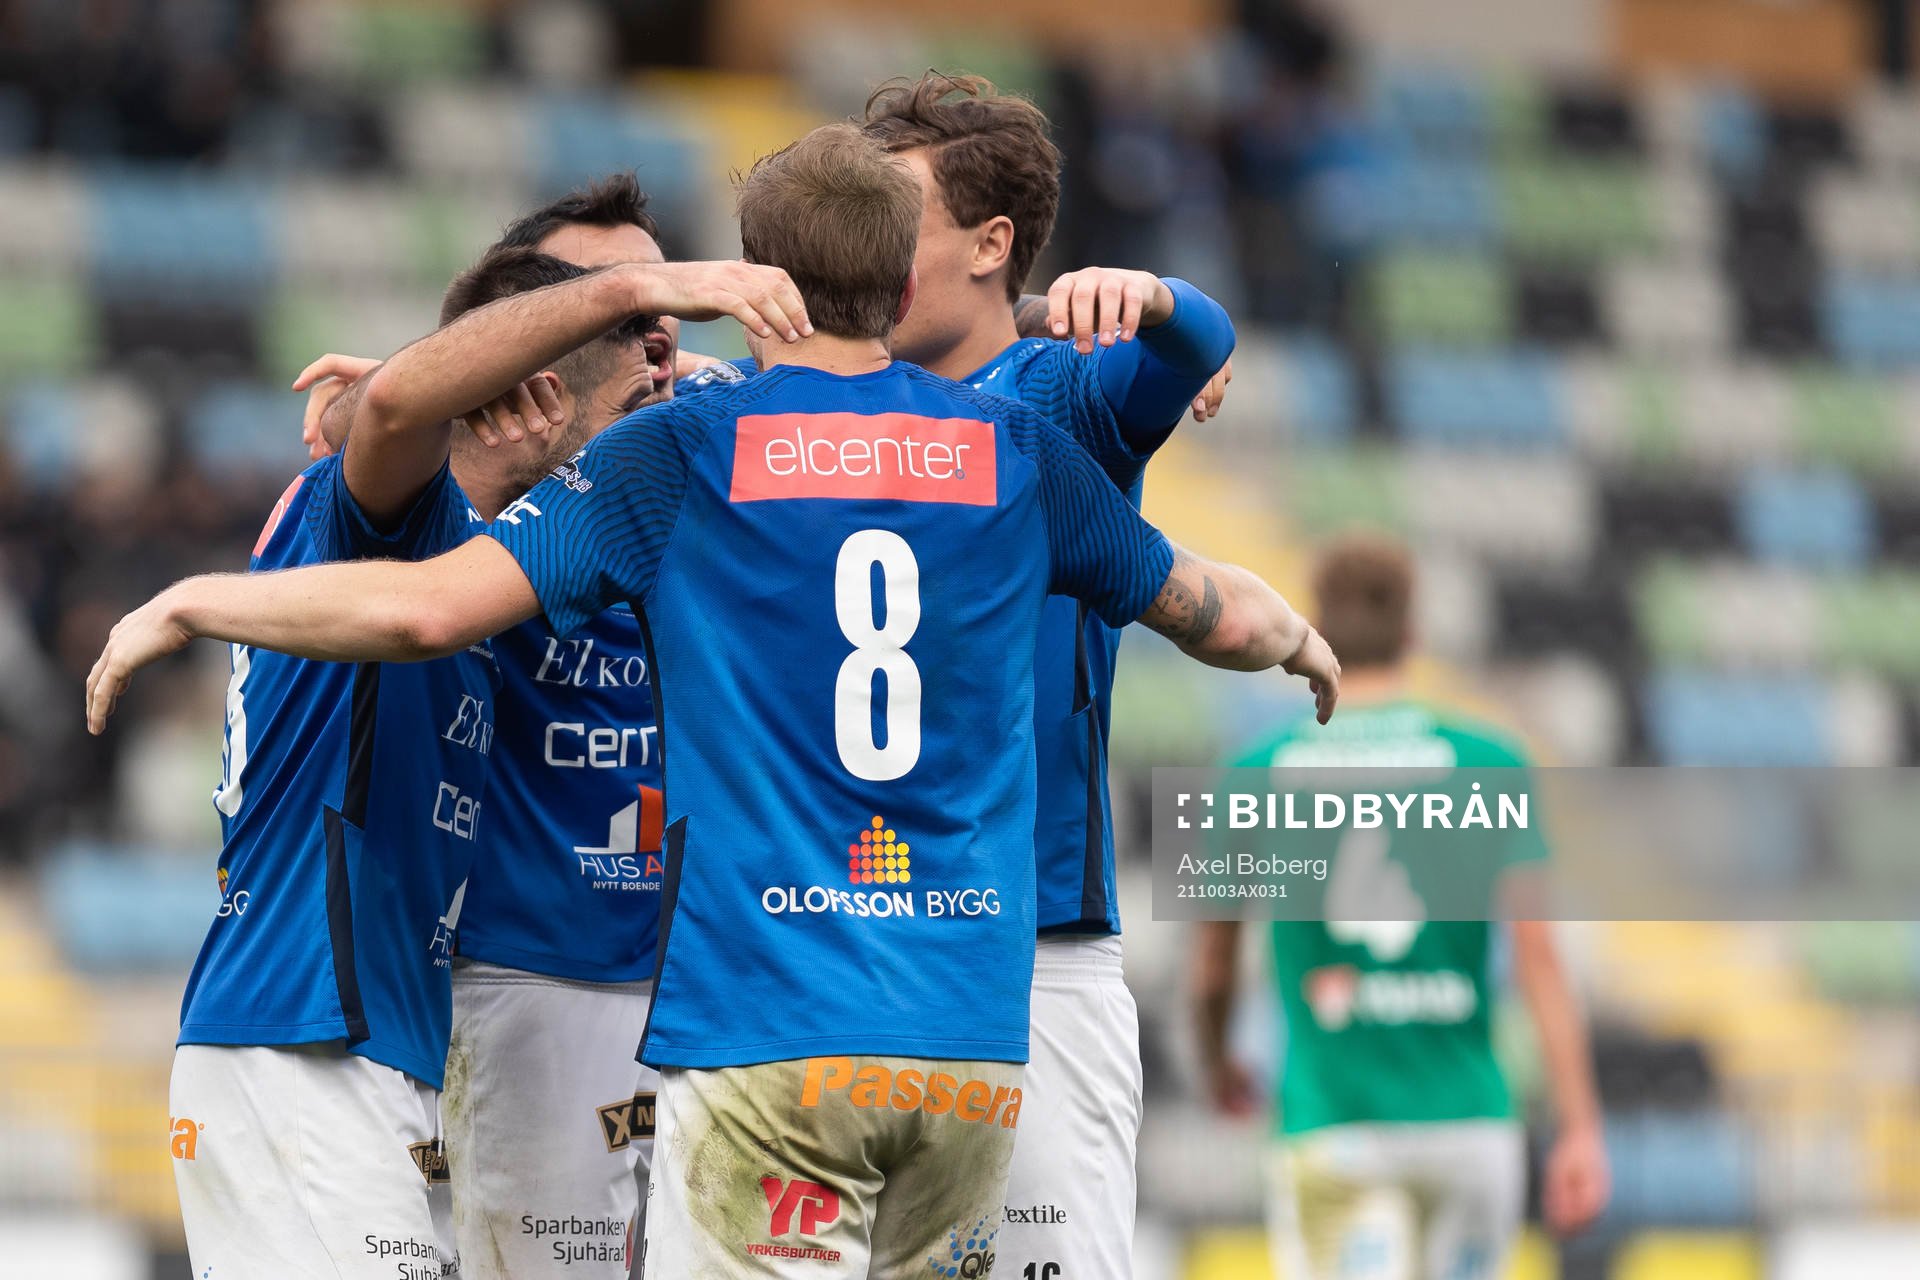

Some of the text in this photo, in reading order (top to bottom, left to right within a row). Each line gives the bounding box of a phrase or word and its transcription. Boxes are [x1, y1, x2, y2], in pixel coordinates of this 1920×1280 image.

[764, 426, 971, 480] elcenter
[531, 636, 595, 688] El
[834, 529, 922, 782] 8
[592, 880, 661, 891] NYTT BOENDE
[761, 885, 1001, 918] OLOFSSON BYGG
[800, 1056, 1023, 1130] Passera
[521, 1215, 627, 1239] Sparbanken
[759, 1177, 840, 1238] YP
[1002, 1205, 1067, 1224] extile
[746, 1243, 841, 1263] YRKESBUTIKER
